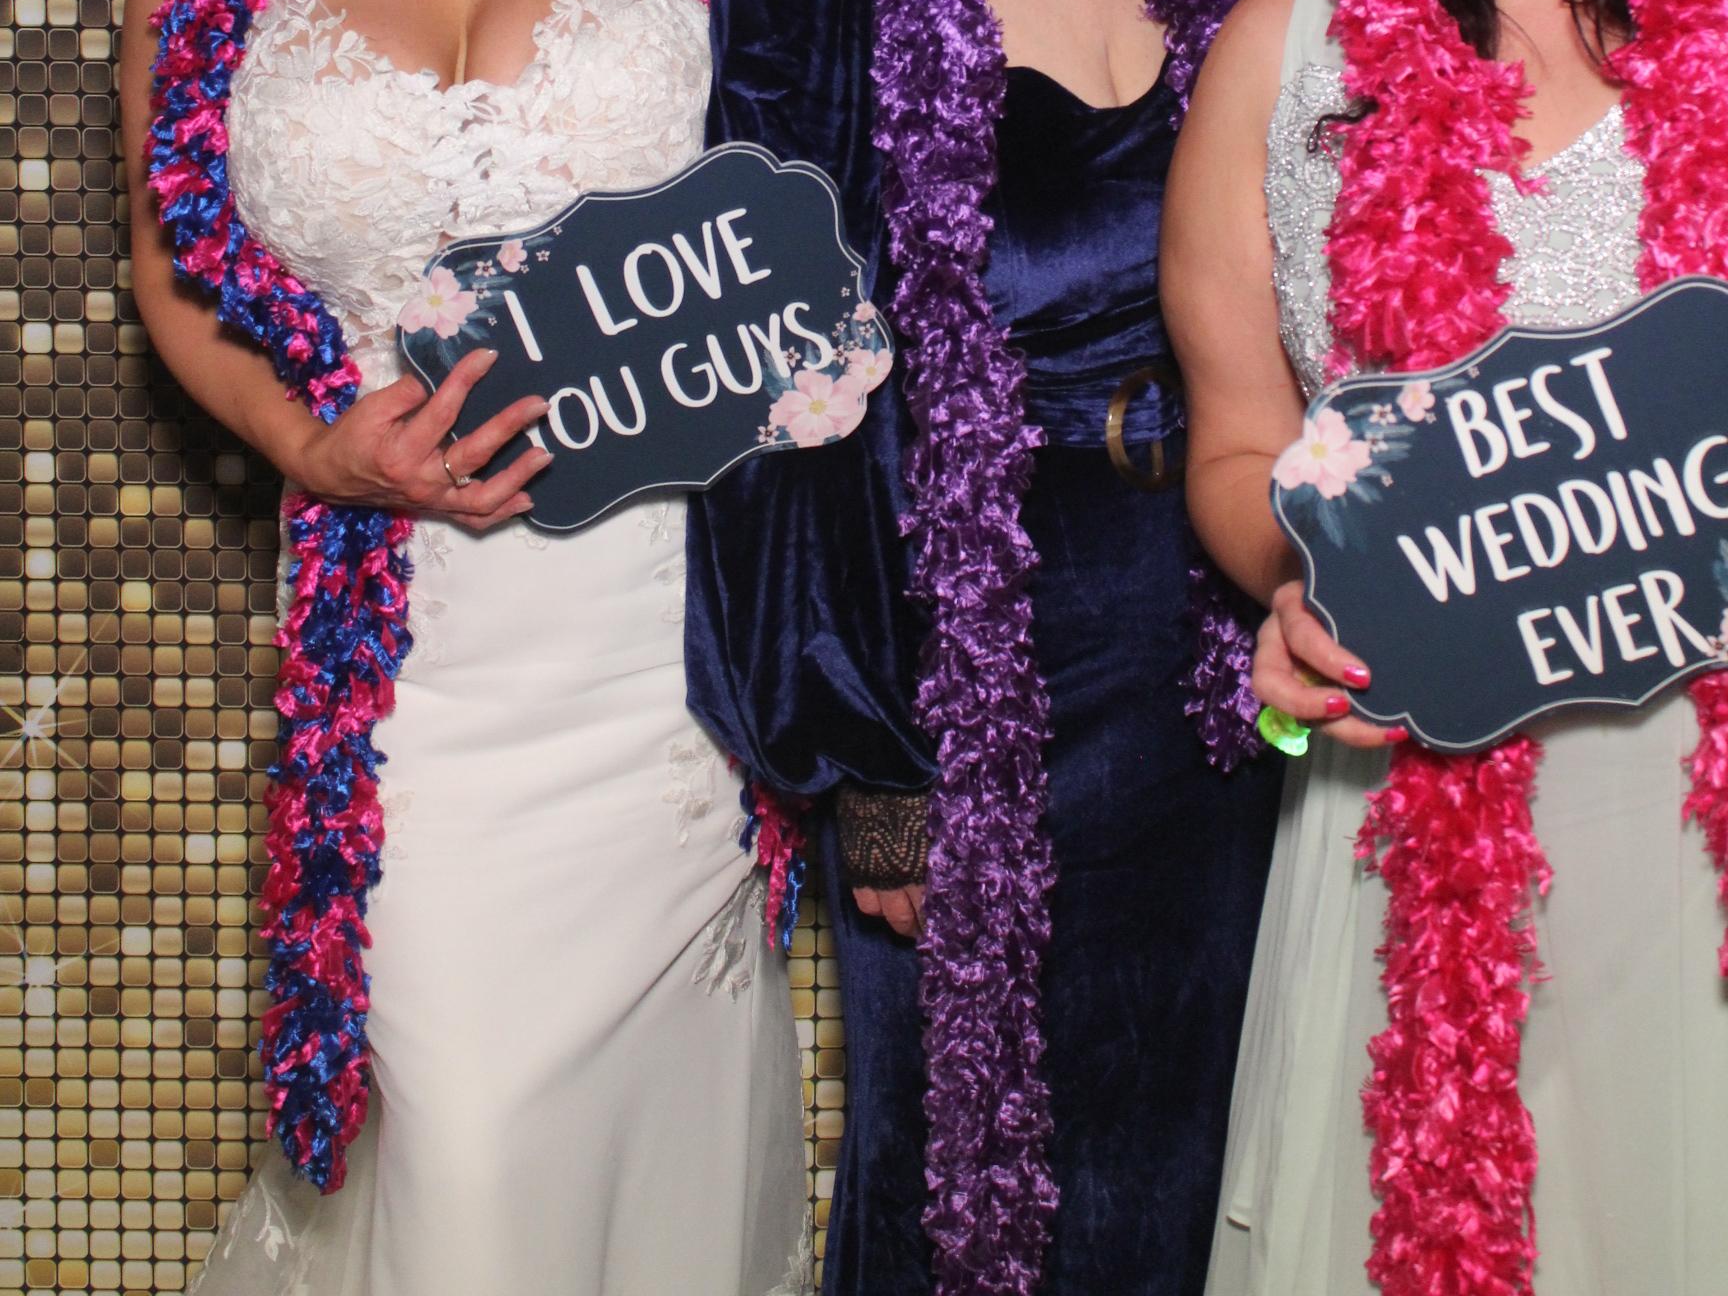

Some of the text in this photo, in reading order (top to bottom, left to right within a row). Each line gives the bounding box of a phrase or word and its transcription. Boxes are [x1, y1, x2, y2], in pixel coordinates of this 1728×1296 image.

[503, 208, 772, 362] I LOVE
[525, 302, 835, 455] OU GUYS
[1446, 347, 1627, 478] BEST
[1397, 435, 1728, 603] WEDDING
[1517, 570, 1715, 686] EVER
